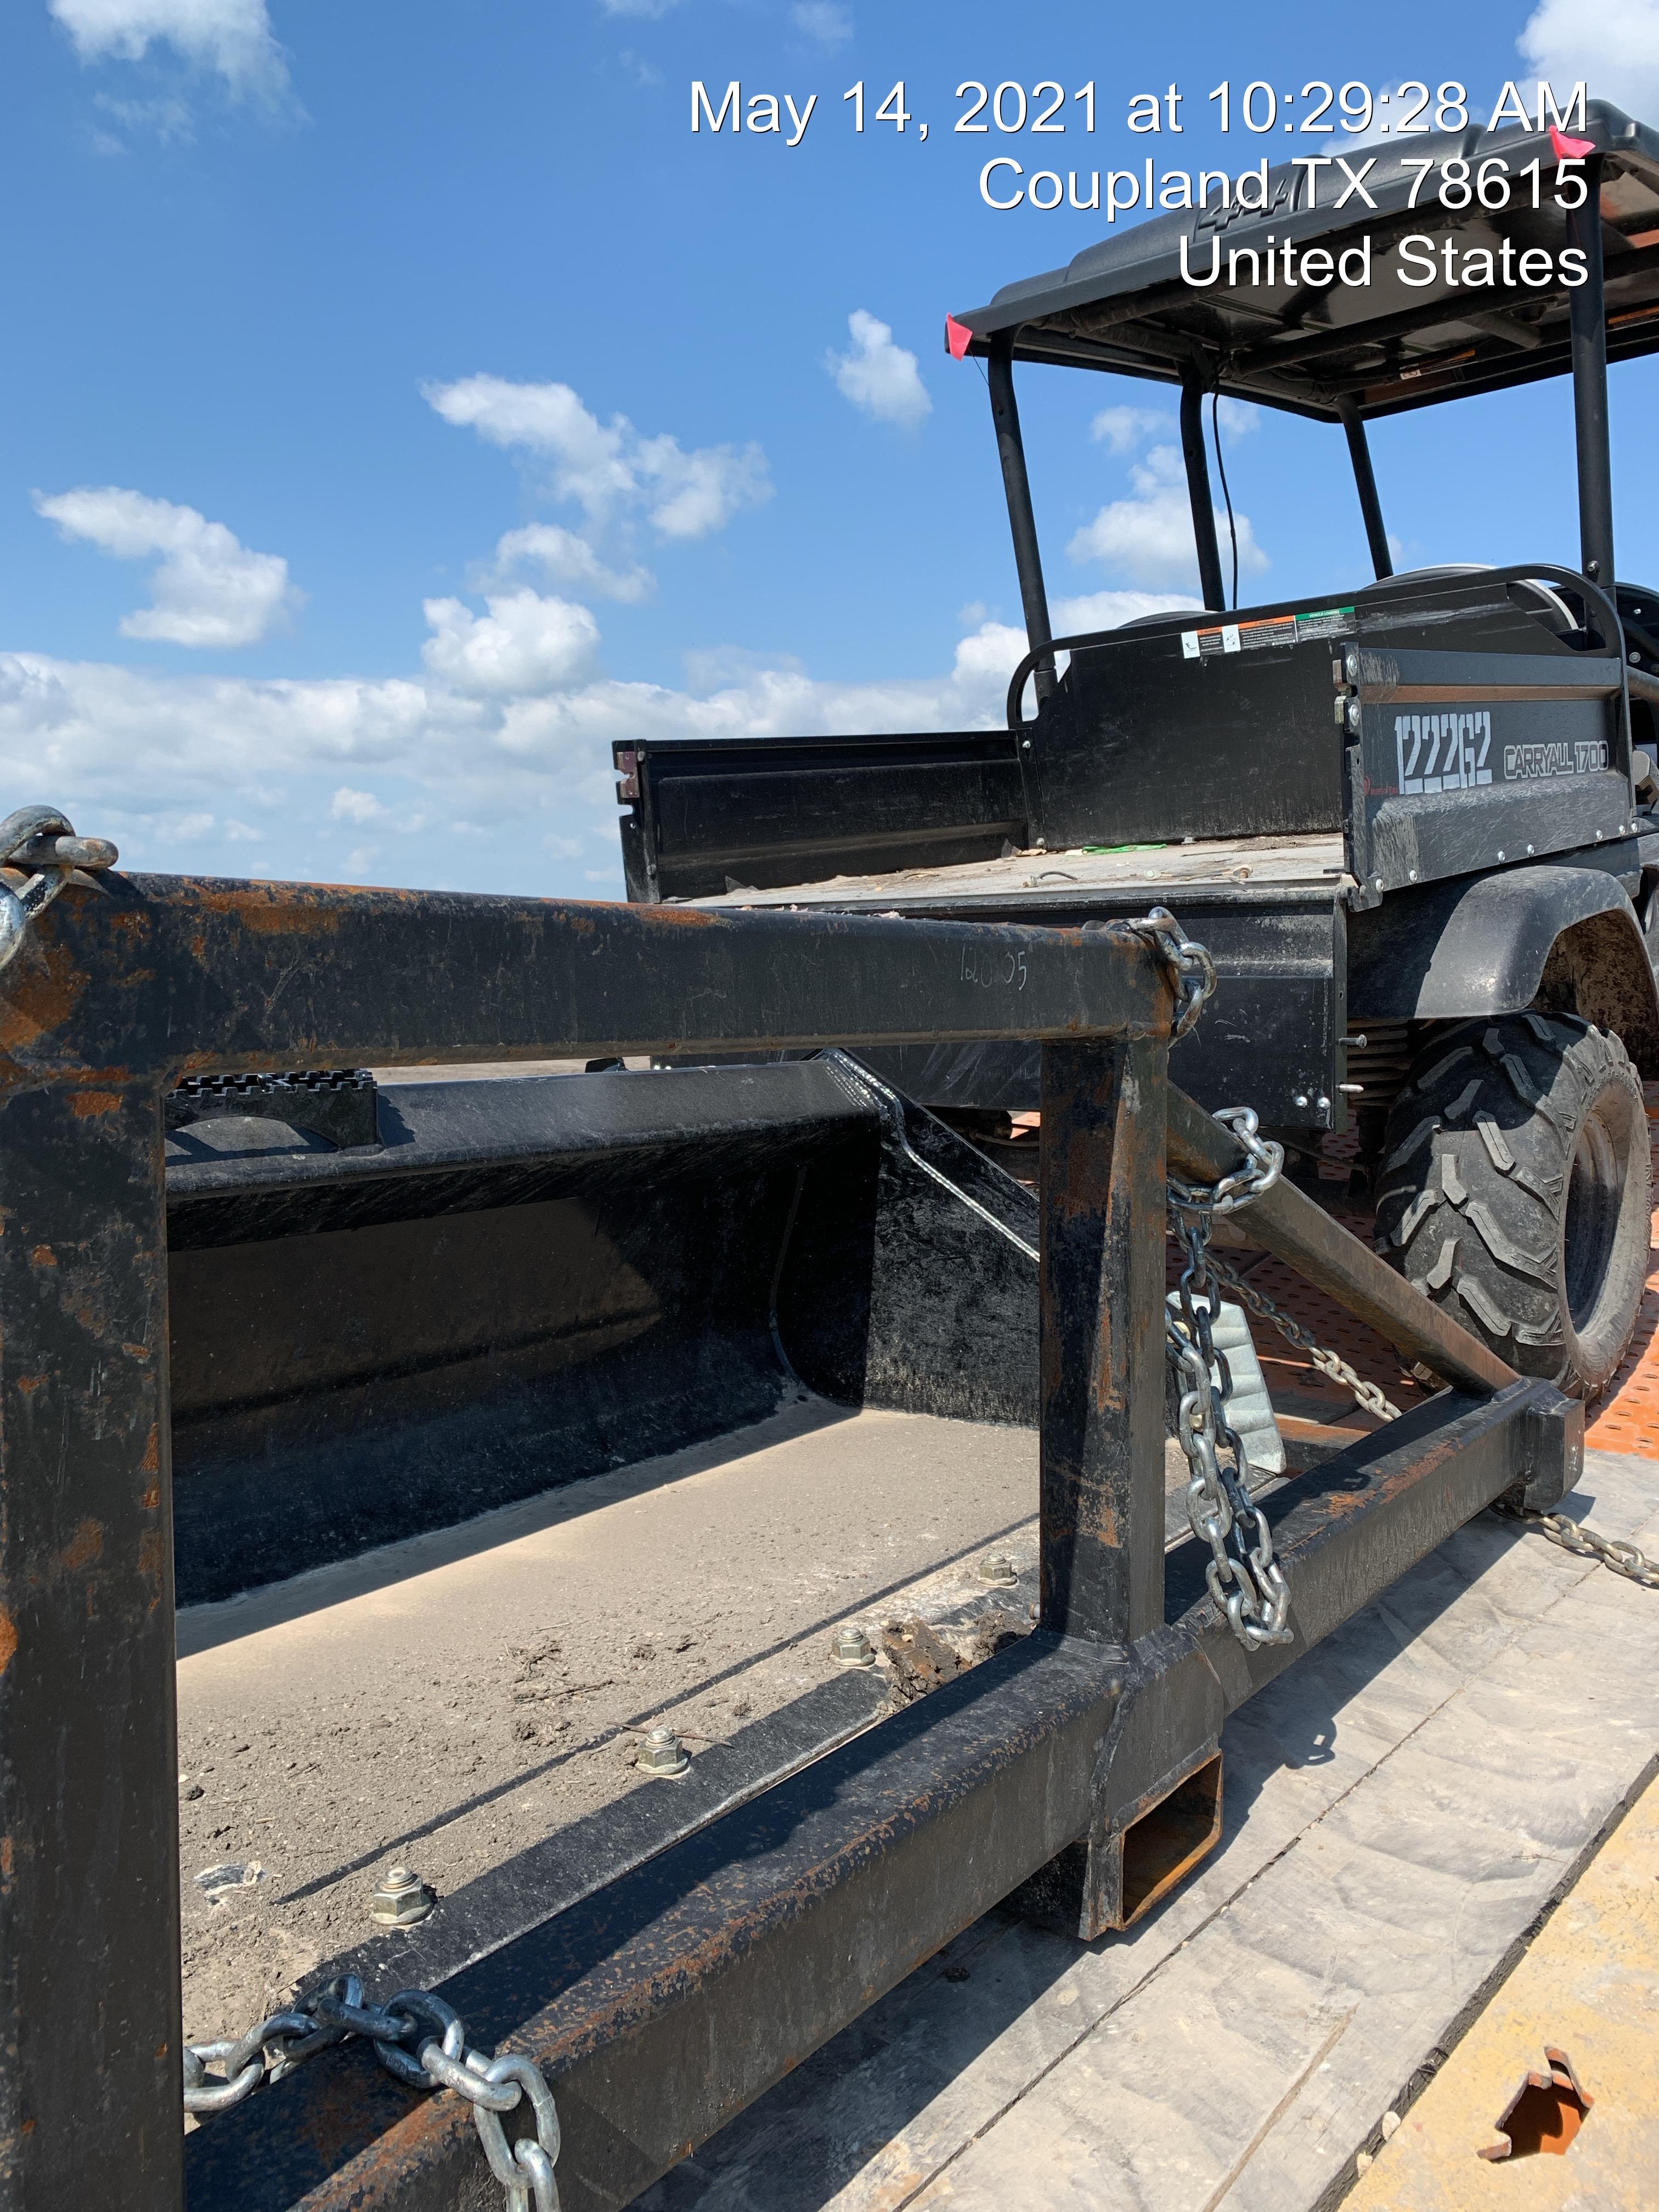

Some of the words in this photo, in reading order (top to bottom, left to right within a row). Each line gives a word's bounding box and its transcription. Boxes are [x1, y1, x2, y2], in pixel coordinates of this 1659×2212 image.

[1394, 710, 1493, 795] 12262
[1503, 742, 1574, 780] CARRYALL
[1574, 740, 1609, 774] 1700
